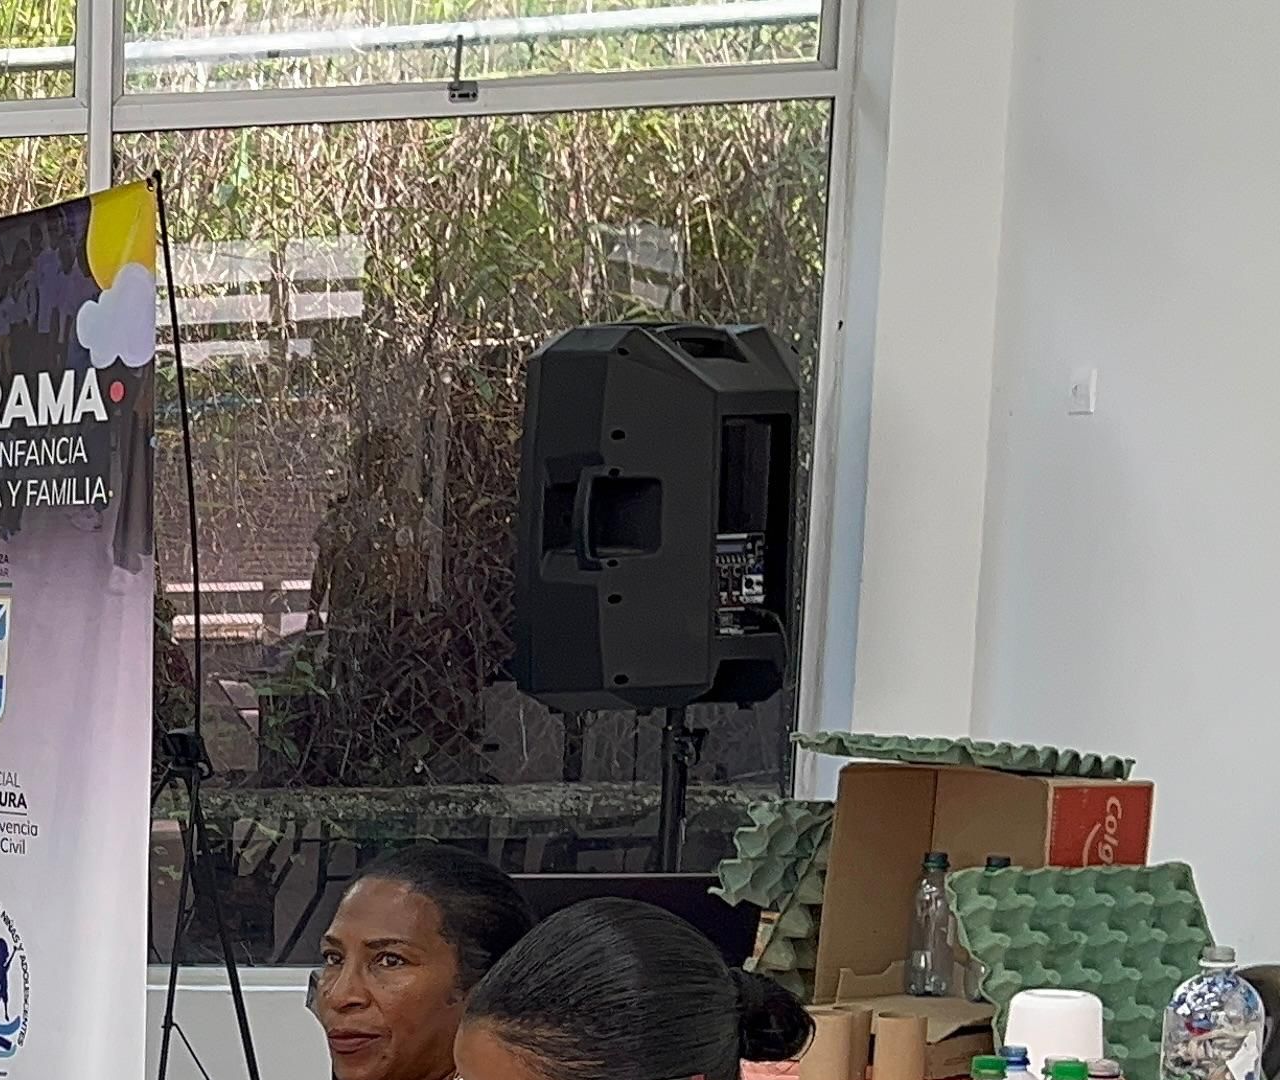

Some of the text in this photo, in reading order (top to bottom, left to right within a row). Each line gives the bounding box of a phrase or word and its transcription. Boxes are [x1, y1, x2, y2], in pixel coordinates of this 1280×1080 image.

[7, 480, 20, 506] Y
[26, 476, 107, 506] FAMILIA
[0, 837, 26, 855] Civil
[1098, 796, 1122, 866] Colg
